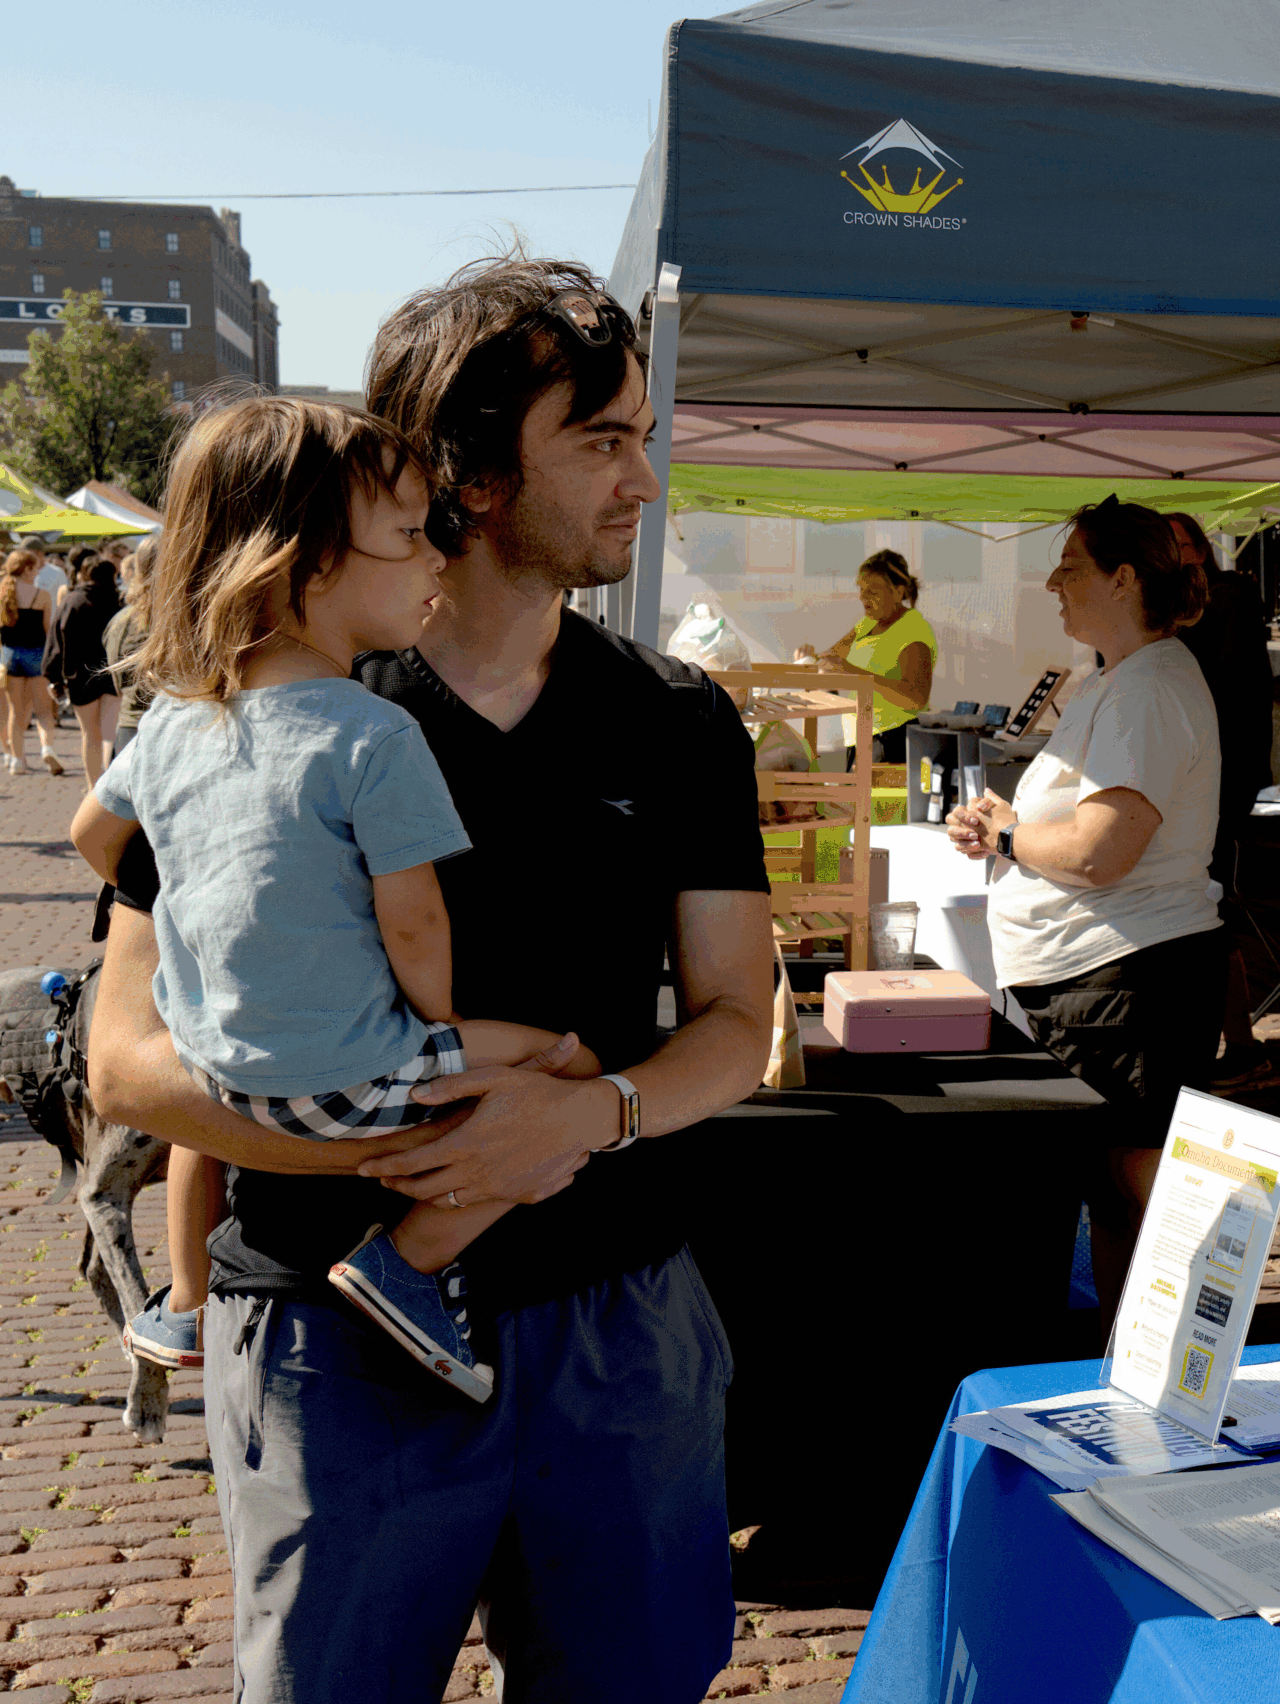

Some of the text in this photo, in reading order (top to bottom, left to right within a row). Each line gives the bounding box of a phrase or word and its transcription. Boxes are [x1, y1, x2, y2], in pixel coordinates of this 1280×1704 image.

[843, 211, 898, 227] CROWN
[18, 303, 148, 323] LOTS
[1180, 1143, 1211, 1166] Omaha
[1192, 1328, 1217, 1347] READ MORE
